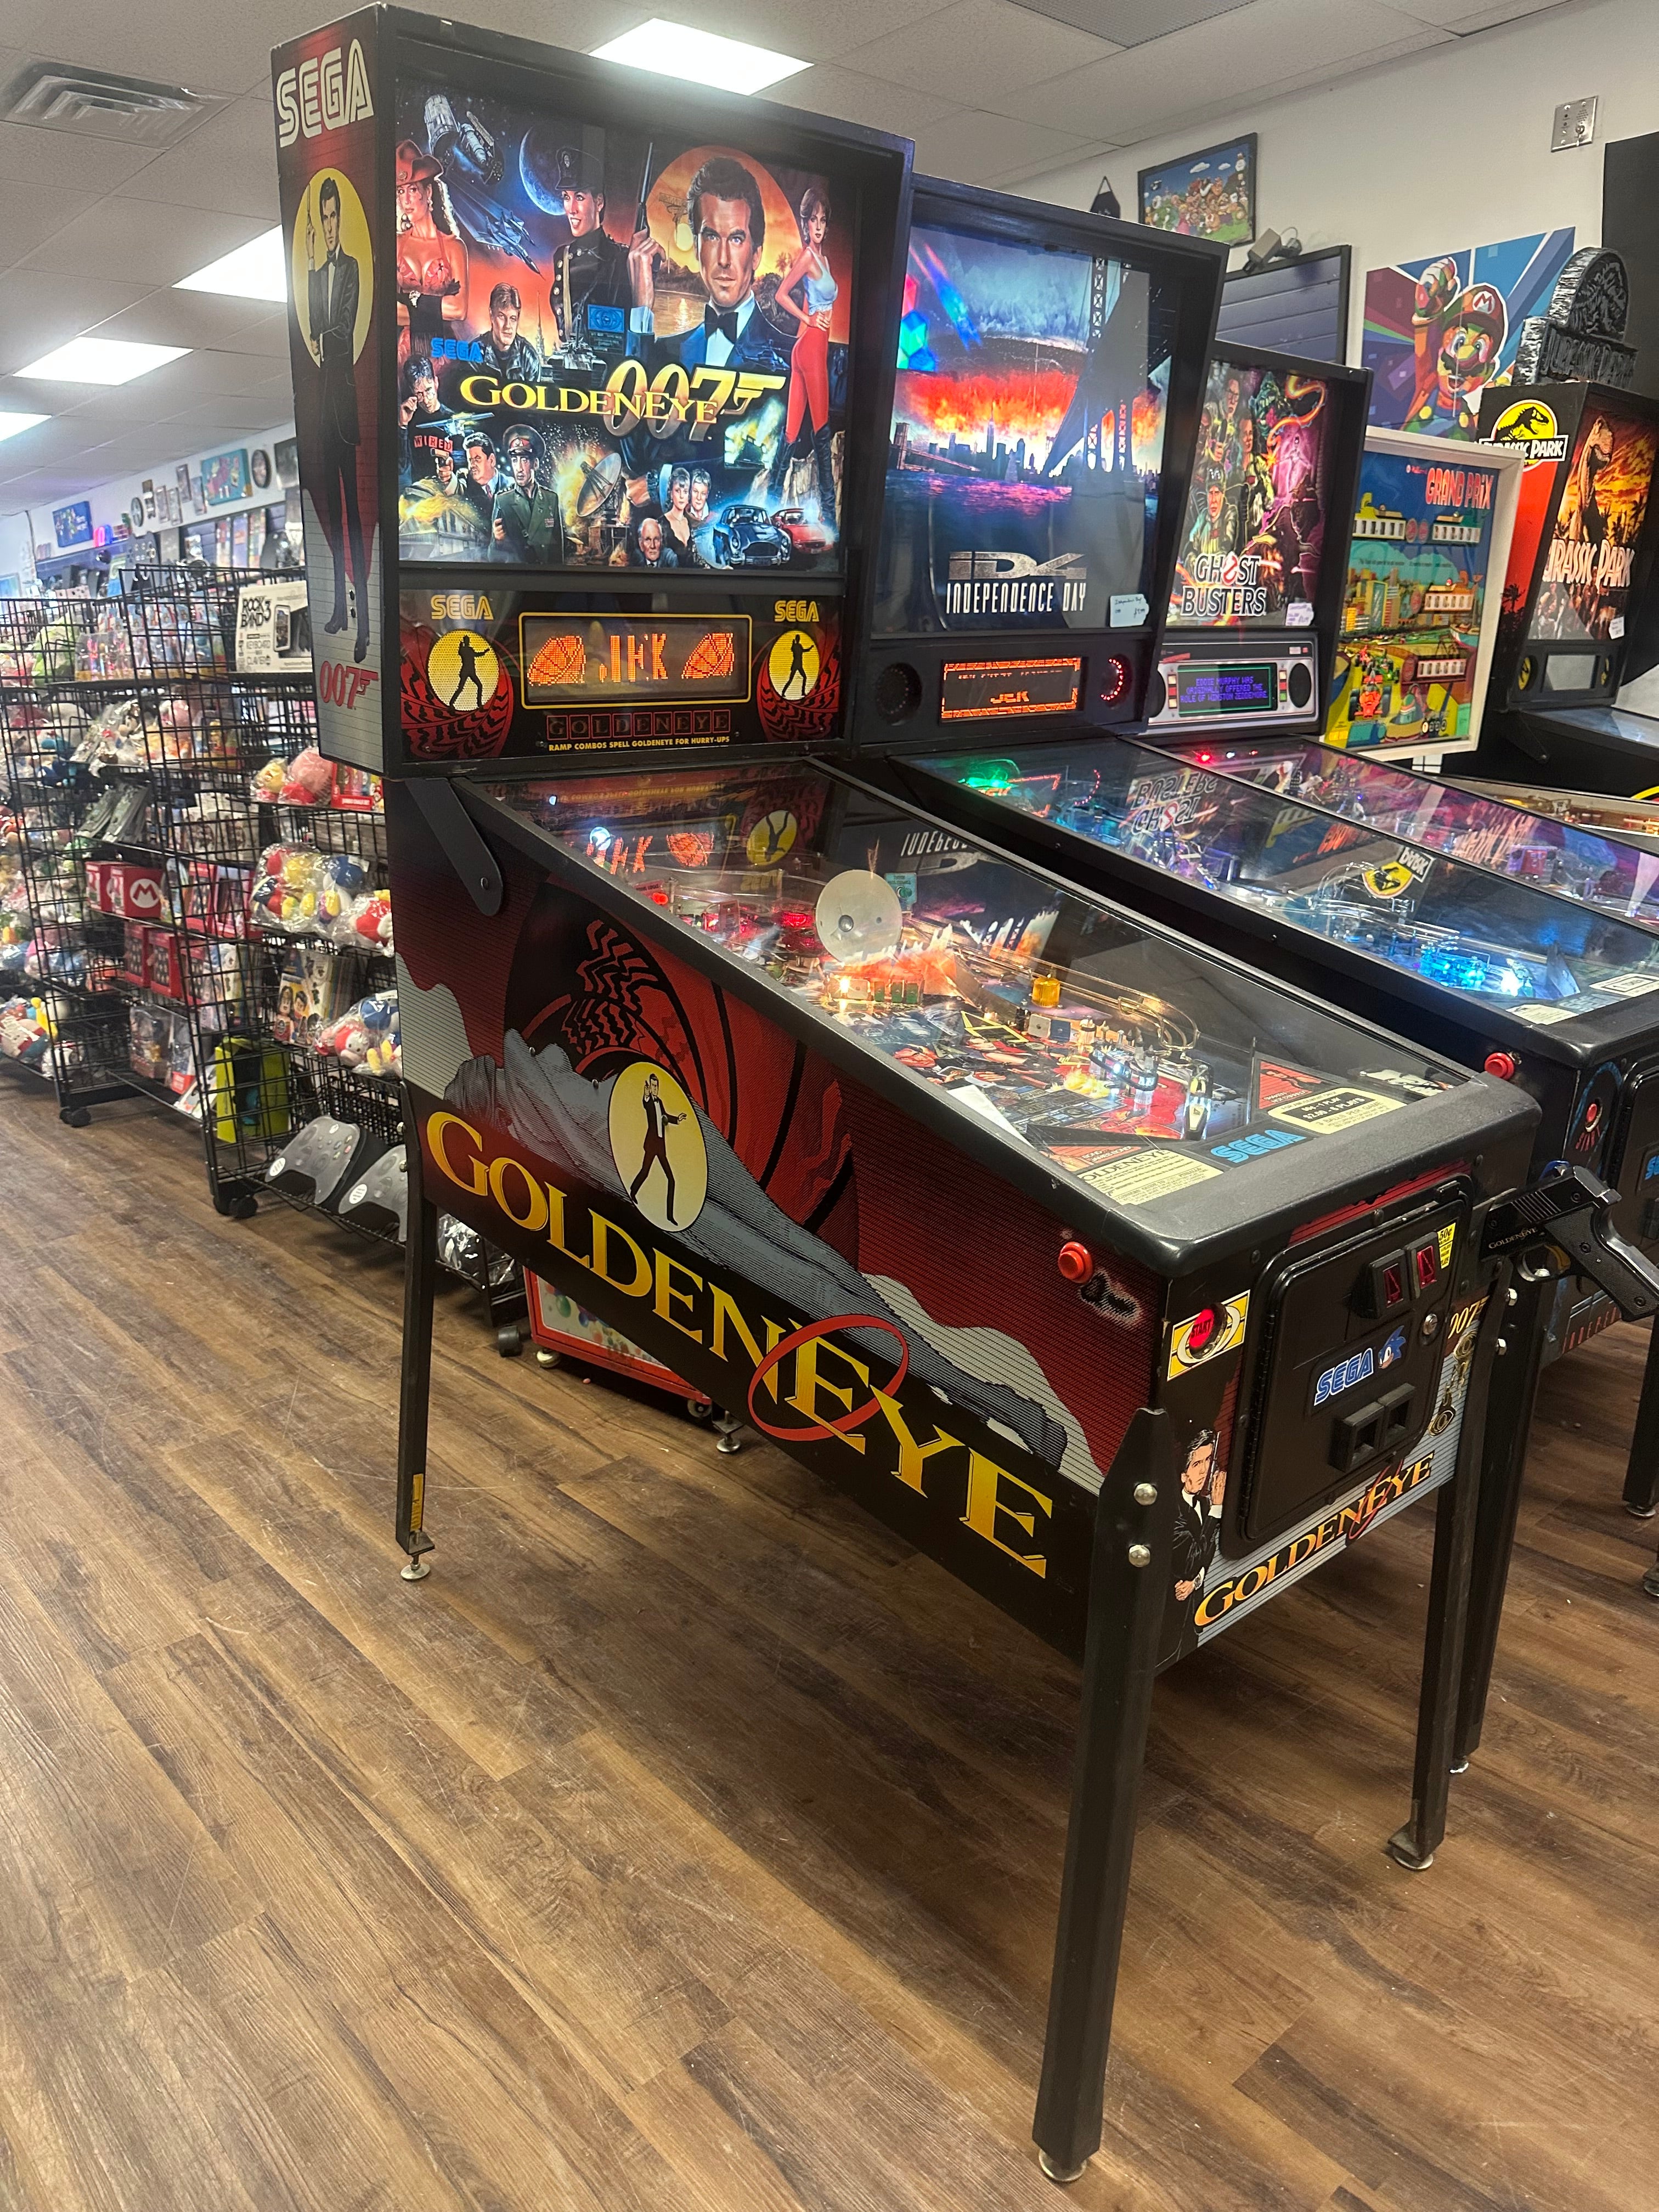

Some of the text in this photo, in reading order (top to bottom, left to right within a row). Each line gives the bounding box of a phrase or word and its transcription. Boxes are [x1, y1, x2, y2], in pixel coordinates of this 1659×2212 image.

[276, 38, 374, 148] SEGA
[431, 337, 484, 364] SEGA
[460, 376, 718, 425] GOLDENEYE
[604, 360, 746, 442] 007
[414, 435, 453, 452] WIRED
[1530, 439, 1564, 459] PARK
[1425, 467, 1465, 507] GRAND
[949, 550, 1087, 580] ID4
[1595, 539, 1635, 595] PARK
[242, 595, 265, 614] ROCK
[431, 594, 494, 620] SEGA
[774, 600, 820, 622] SEGA
[946, 582, 1087, 614] INDEPENDENCE DAY
[1181, 585, 1267, 617] BUSTERS
[240, 612, 264, 630] BAND
[319, 660, 366, 709] 007
[1216, 677, 1239, 685] MURPHY
[574, 742, 607, 750] COMBOS
[631, 739, 673, 747] GOLDENEYE
[1336, 1097, 1366, 1110] PLAYS
[1209, 1128, 1306, 1164] SEGA
[1488, 1227, 1538, 1249] GOLDENEYE
[1190, 1318, 1212, 1338] START
[426, 1110, 1053, 1578] GOLDENEYE
[1313, 1347, 1375, 1406] SEGA
[1194, 1451, 1435, 1628] GOLDENEYE
